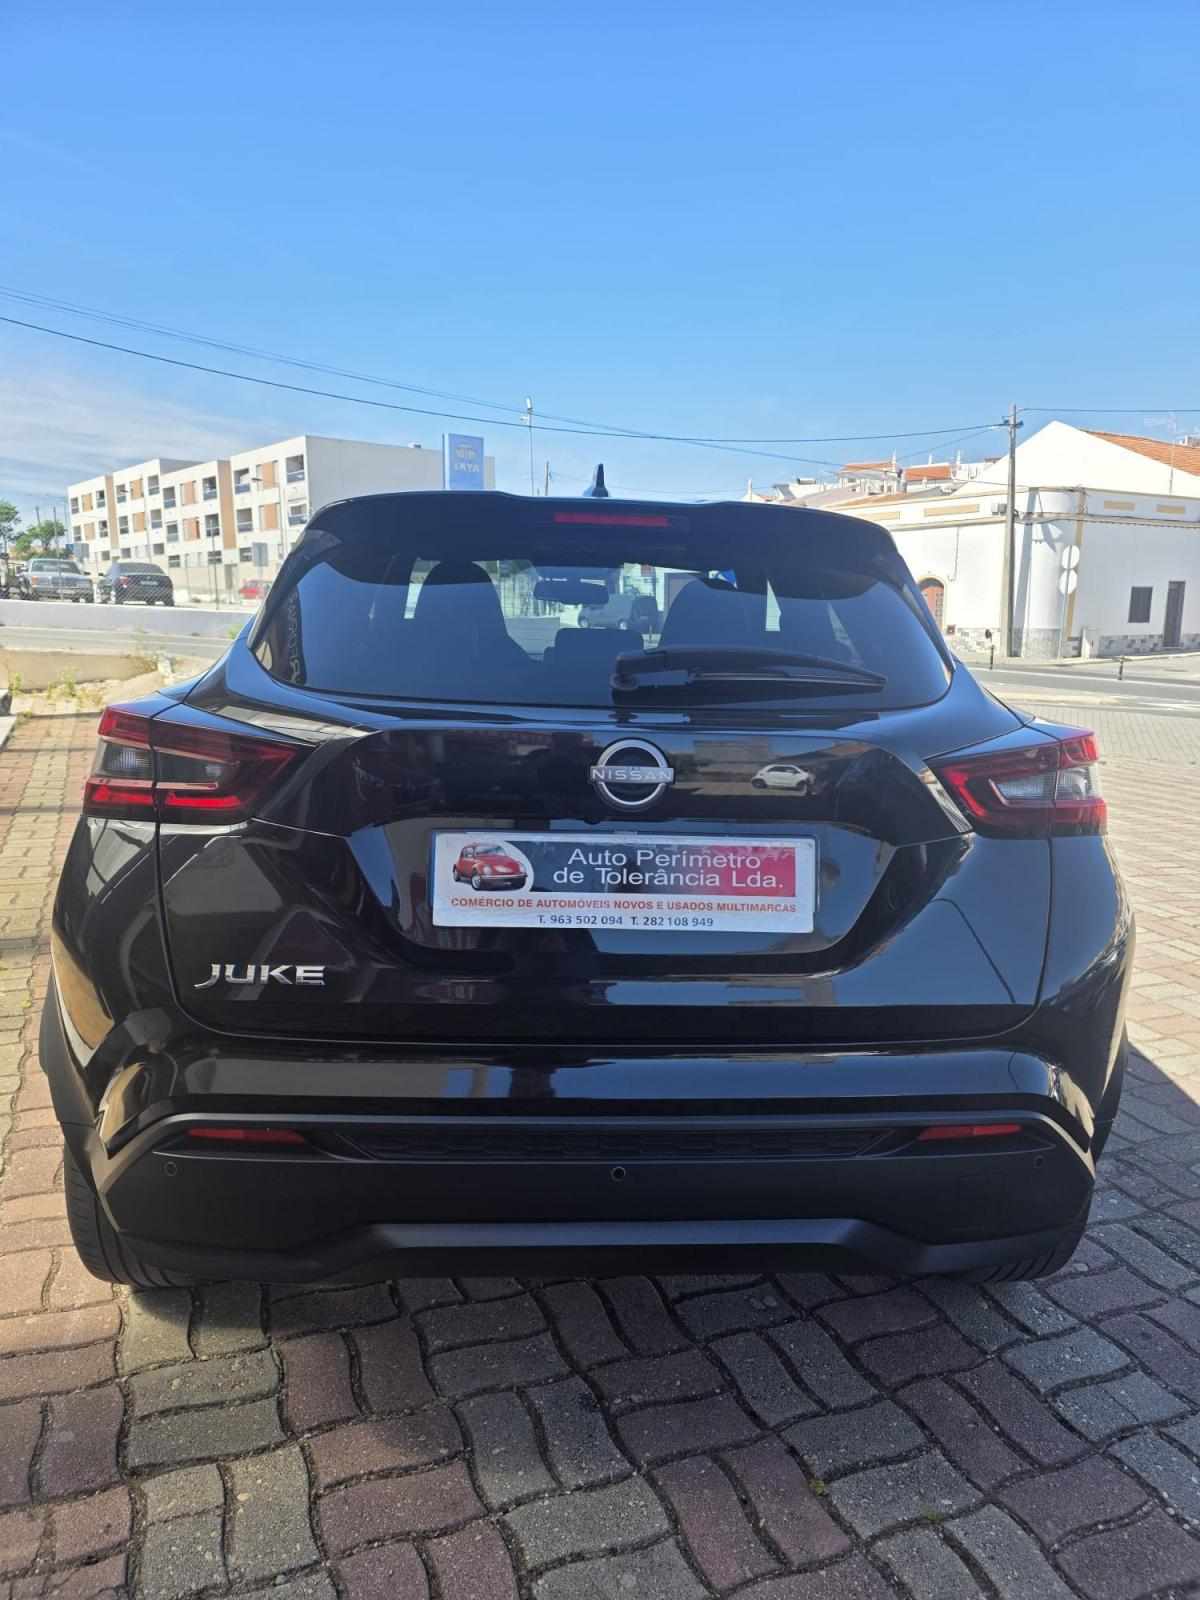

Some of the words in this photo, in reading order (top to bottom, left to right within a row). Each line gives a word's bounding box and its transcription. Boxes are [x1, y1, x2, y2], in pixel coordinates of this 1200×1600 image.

[591, 768, 672, 781] NISSAN
[567, 848, 627, 866] Auto
[636, 849, 761, 869] Perímetro
[553, 867, 585, 884] de
[595, 868, 720, 886] Tolerância
[732, 871, 784, 888] Lda.
[518, 898, 534, 908] DE
[536, 898, 611, 909] AUTOMÓVEIS
[614, 900, 654, 910] NOVOS
[656, 901, 664, 910] E
[667, 901, 713, 911] USADOS
[716, 902, 797, 913] MULTIMARCAS
[538, 915, 547, 924] T.
[550, 915, 572, 925] 963
[576, 915, 597, 925] 502
[601, 915, 623, 925] 094
[631, 916, 639, 926] T.
[643, 916, 664, 926] 282
[667, 917, 689, 927] 108
[692, 917, 714, 927] 949
[193, 963, 326, 989] JUKE
